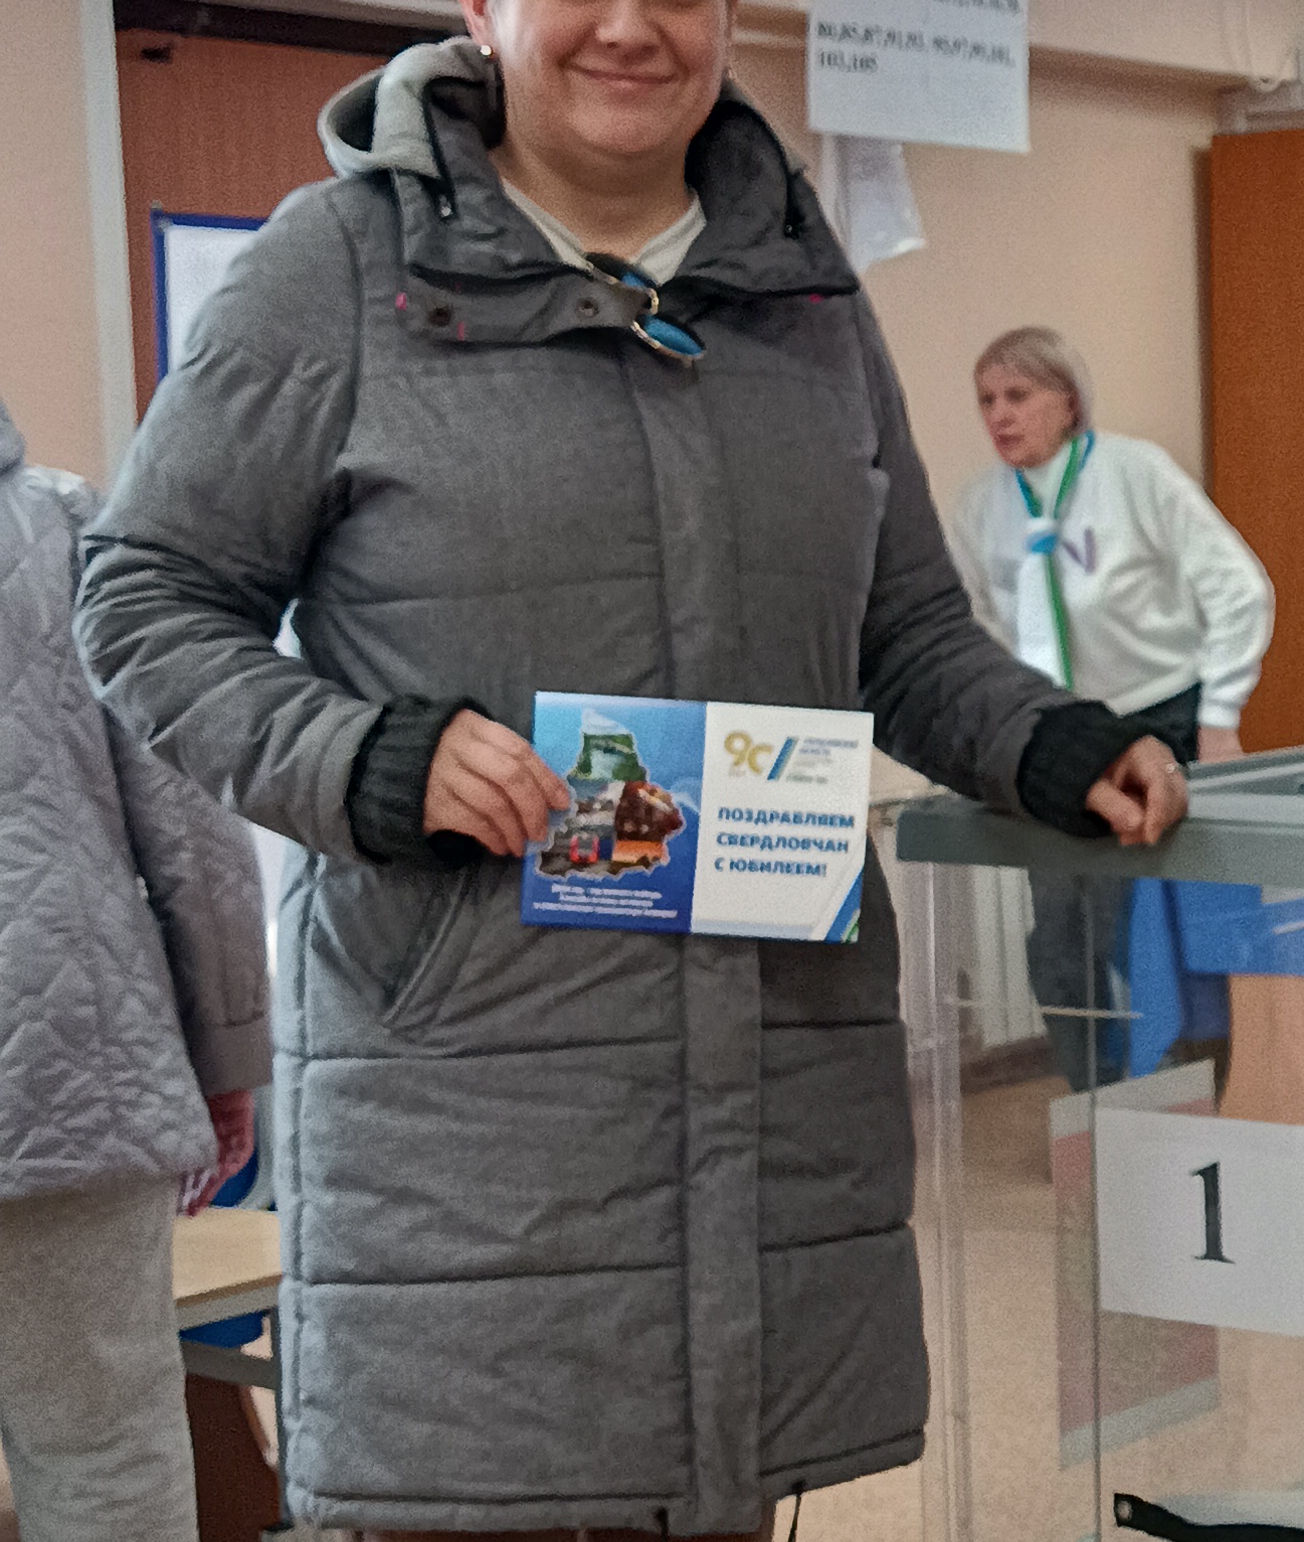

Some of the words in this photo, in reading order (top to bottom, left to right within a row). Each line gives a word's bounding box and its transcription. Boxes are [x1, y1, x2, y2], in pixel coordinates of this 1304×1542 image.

[718, 807, 855, 828] ПОЗДРАВЛЯЕМ
[716, 832, 849, 853] СВЕРДЛОВЧАН
[714, 857, 724, 871] С
[729, 858, 827, 877] ЮБИЛЕЕМ!
[1187, 1161, 1235, 1265] 1
